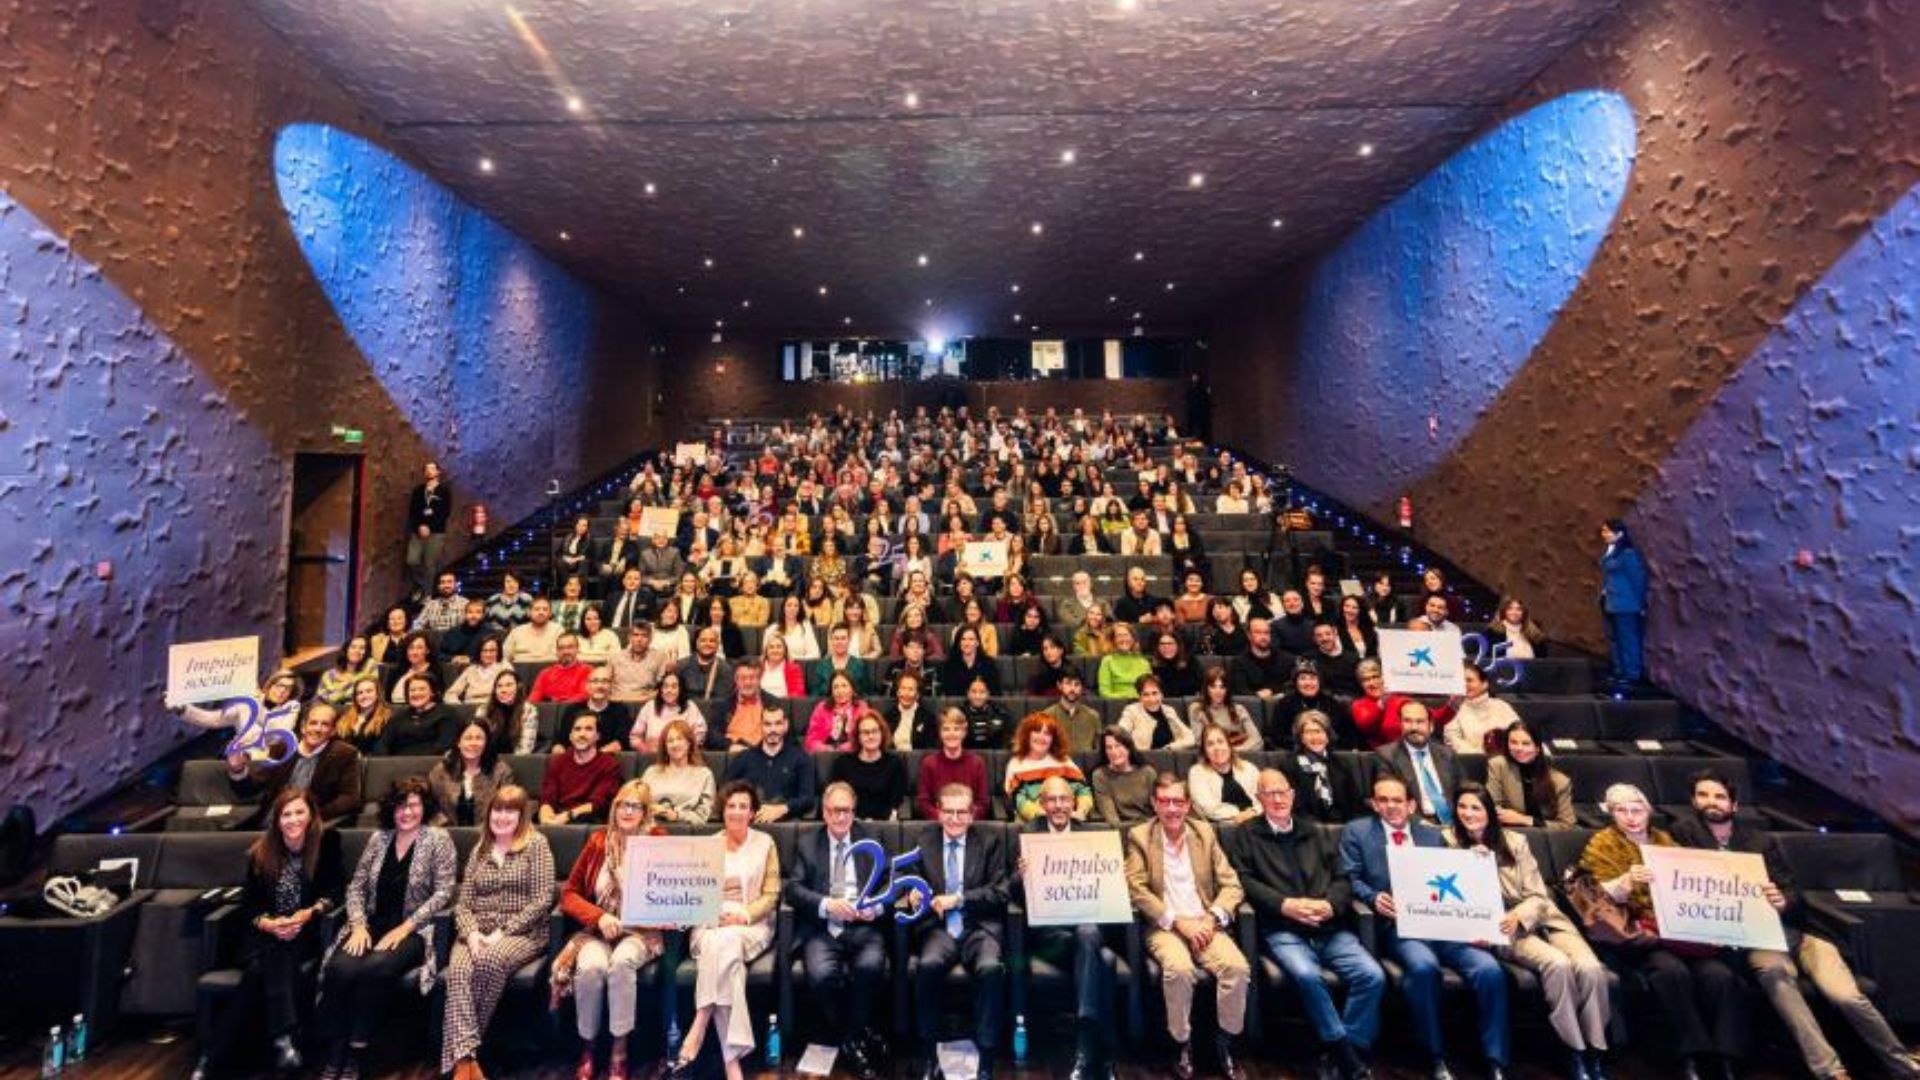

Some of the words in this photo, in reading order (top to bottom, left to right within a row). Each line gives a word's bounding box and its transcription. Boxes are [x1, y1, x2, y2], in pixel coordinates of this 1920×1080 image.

[186, 653, 254, 674] Impulso
[184, 670, 234, 690] social
[222, 696, 298, 767] 25
[1043, 853, 1119, 880] Impulso
[647, 871, 717, 888] Proyectos
[846, 839, 933, 924] 25
[1043, 877, 1100, 901] social
[1672, 869, 1764, 898] Impulso
[645, 891, 702, 906] Sociales
[1676, 899, 1743, 922] social
